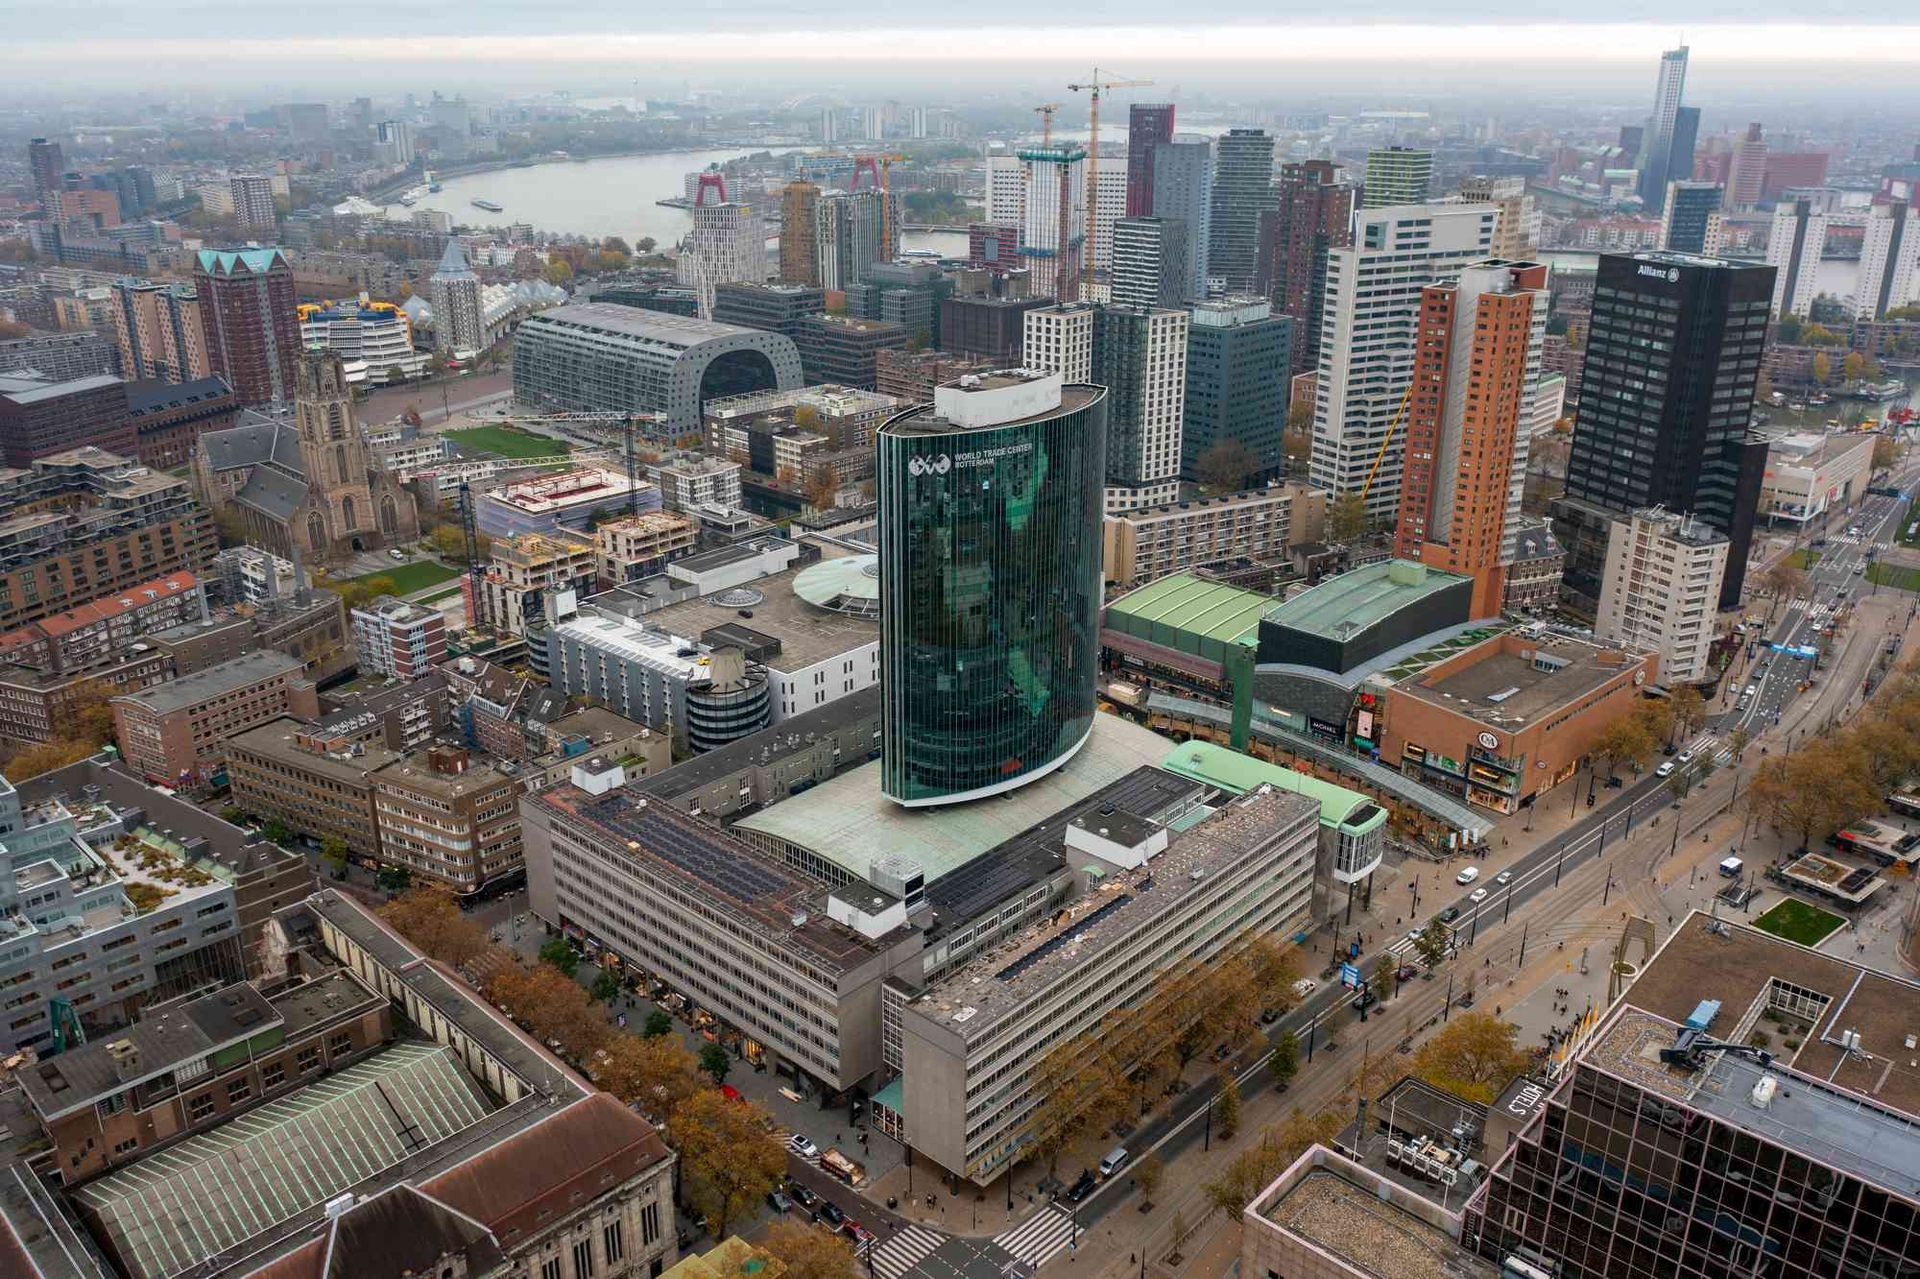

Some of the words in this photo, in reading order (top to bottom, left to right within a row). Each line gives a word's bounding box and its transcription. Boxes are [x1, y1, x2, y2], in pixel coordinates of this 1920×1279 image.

[1637, 264, 1667, 279] Allianz
[954, 451, 981, 462] WORLD
[982, 447, 1006, 458] TRADE
[1007, 443, 1033, 454] CENTER
[954, 458, 994, 468] ROTTERDAM
[1508, 1081, 1546, 1115] HOTELS
